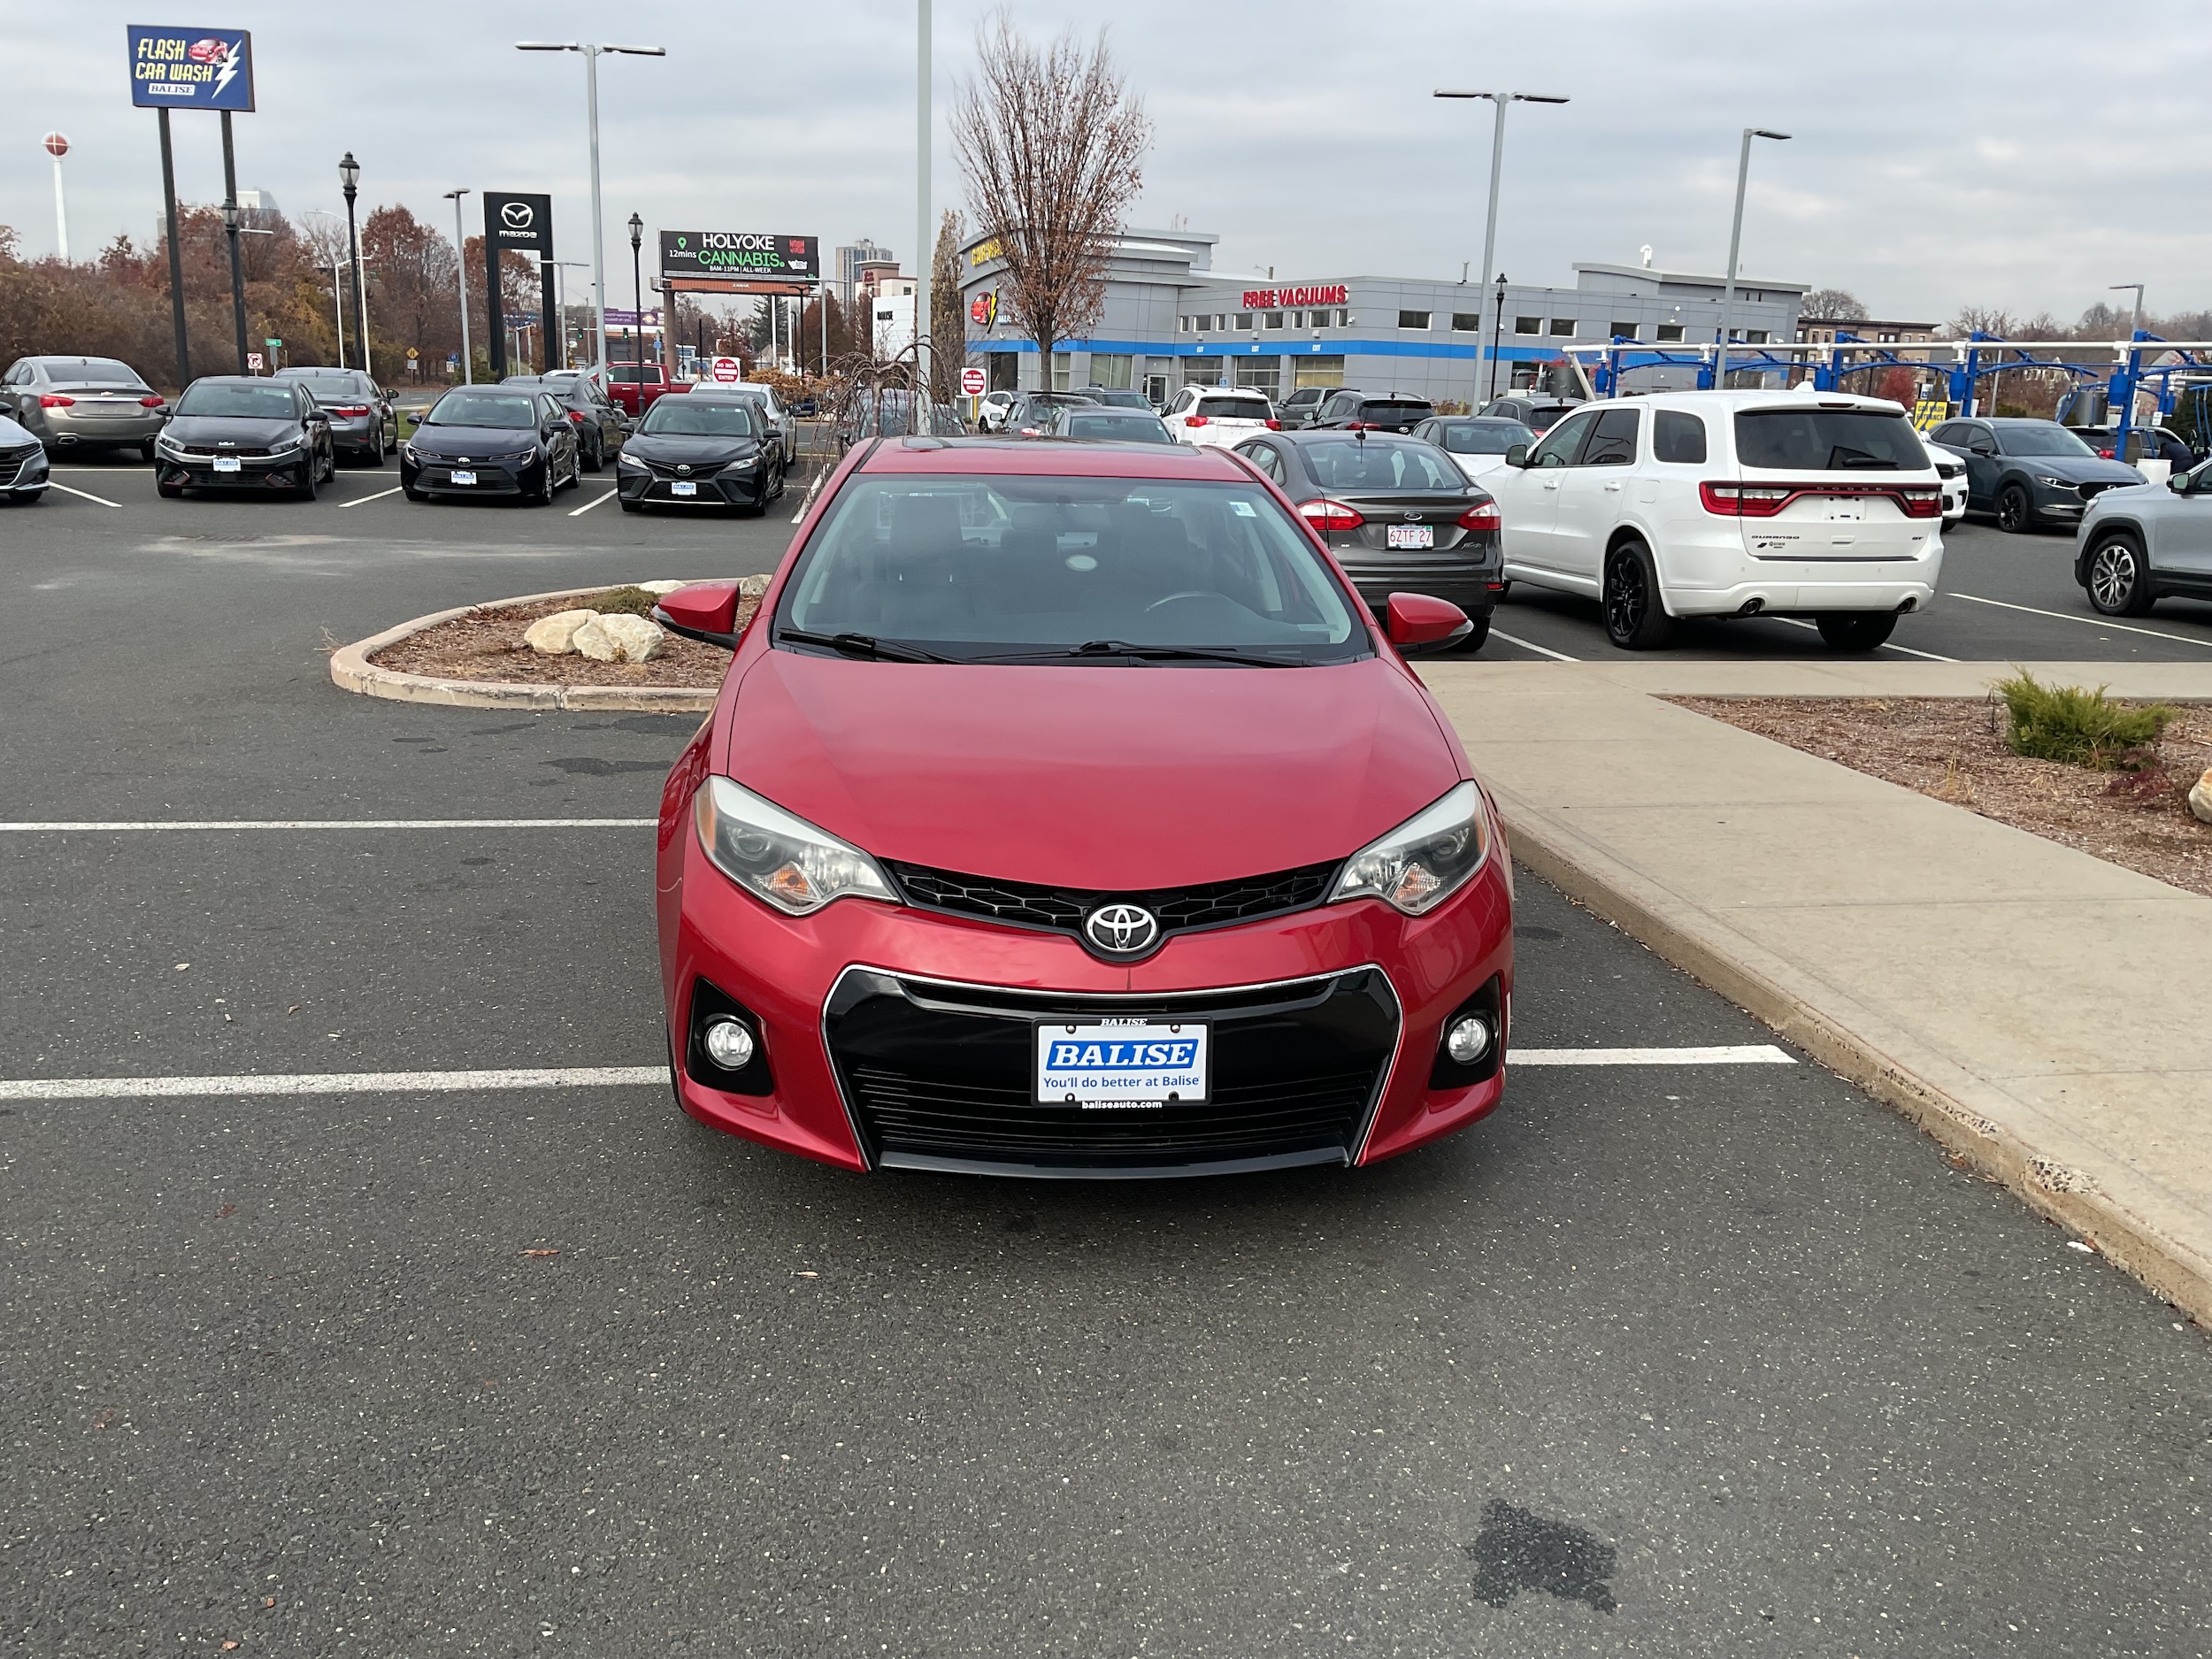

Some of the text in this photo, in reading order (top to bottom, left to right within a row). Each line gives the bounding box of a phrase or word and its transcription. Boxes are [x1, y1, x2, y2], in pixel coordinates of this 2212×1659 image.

[137, 38, 186, 61] FLASH
[135, 61, 213, 82] CAR WASH
[150, 85, 193, 94] BALISE
[703, 233, 775, 251] HOLYOKE
[669, 250, 697, 259] 12mins
[971, 244, 986, 266] CAR
[709, 265, 740, 273] 8AM-11PM
[1242, 285, 1349, 308] FREE VACUUMS
[1389, 530, 1432, 542] 6ZTF 27
[1100, 1018, 1148, 1026] BALISE
[1051, 1041, 1194, 1067] BALISE
[1043, 1075, 1200, 1088] You'll do better at Balise
[1081, 1100, 1163, 1110] baliseauto.com
